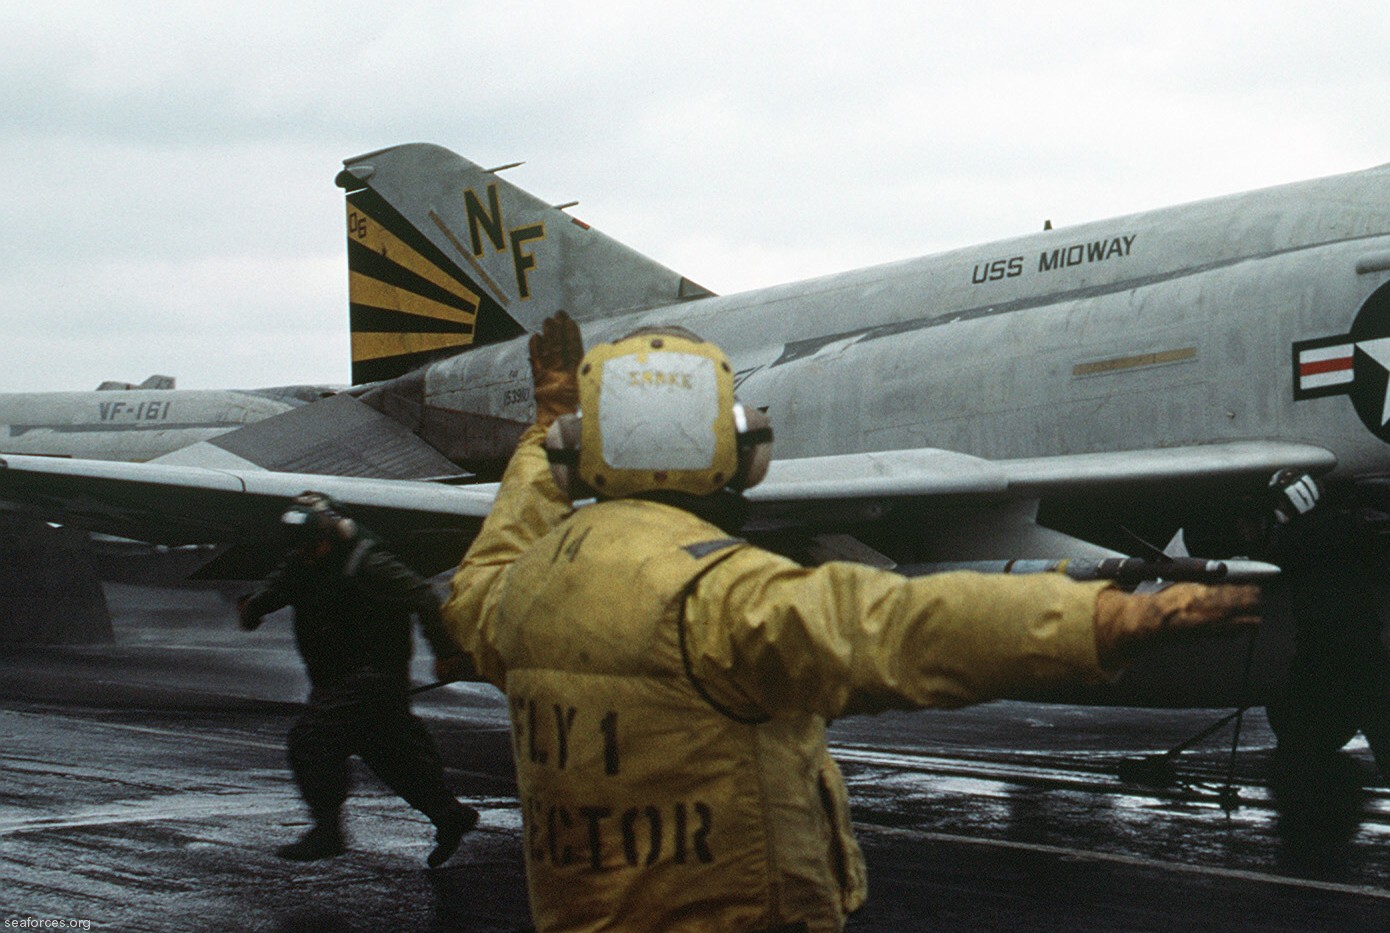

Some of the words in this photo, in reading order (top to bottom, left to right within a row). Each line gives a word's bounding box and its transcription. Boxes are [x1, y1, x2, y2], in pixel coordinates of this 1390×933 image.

[350, 211, 367, 239] 06
[463, 182, 547, 304] NF
[971, 256, 1024, 284] USS
[1038, 234, 1137, 273] MIDWAY
[99, 401, 172, 420] VF-161
[551, 525, 593, 564] 14
[601, 710, 620, 776] 1
